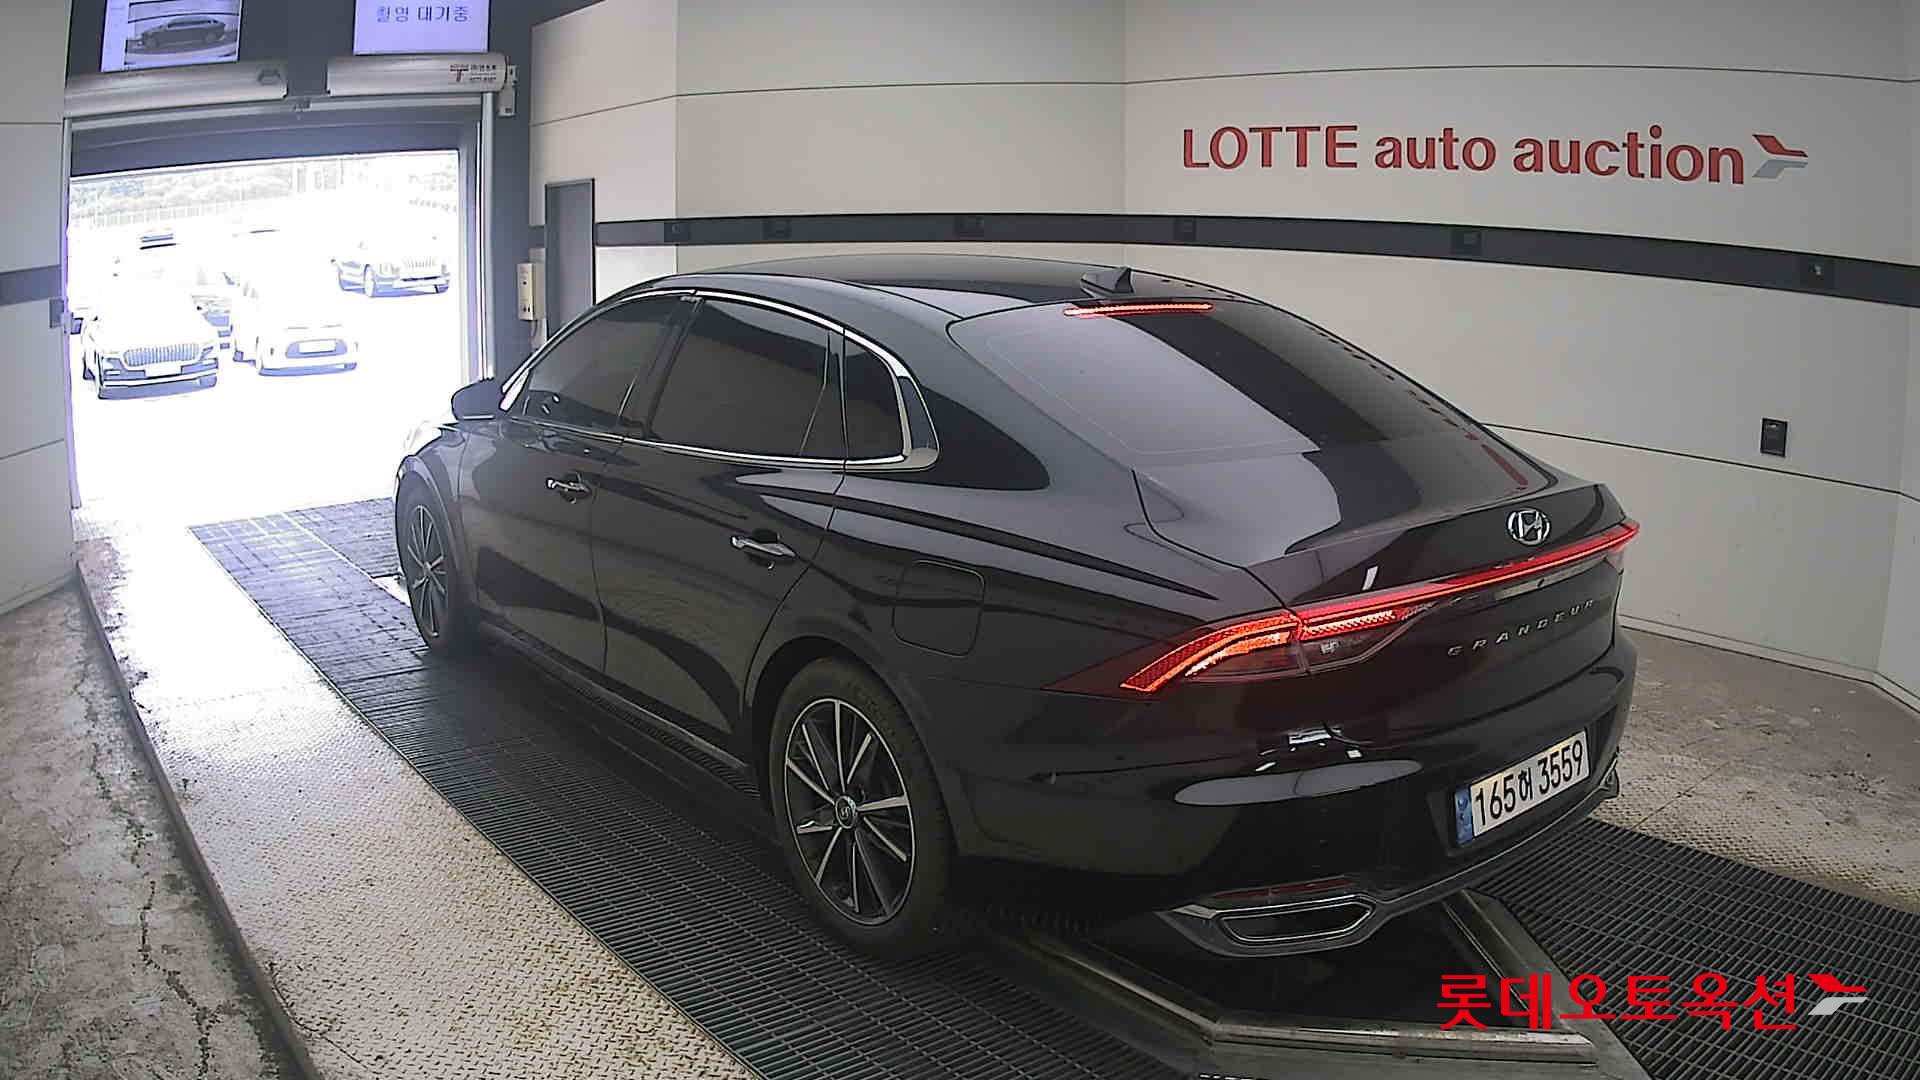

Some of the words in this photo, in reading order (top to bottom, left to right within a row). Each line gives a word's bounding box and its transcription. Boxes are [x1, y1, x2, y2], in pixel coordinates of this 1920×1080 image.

[418, 6, 469, 23] 대기중
[1183, 125, 1358, 169] LOTTE
[1375, 127, 1497, 171] auto
[1513, 124, 1744, 184] auction
[1447, 599, 1593, 656] GRANDEUR
[1475, 767, 1533, 826] 165허
[1537, 740, 1583, 795] 3559
